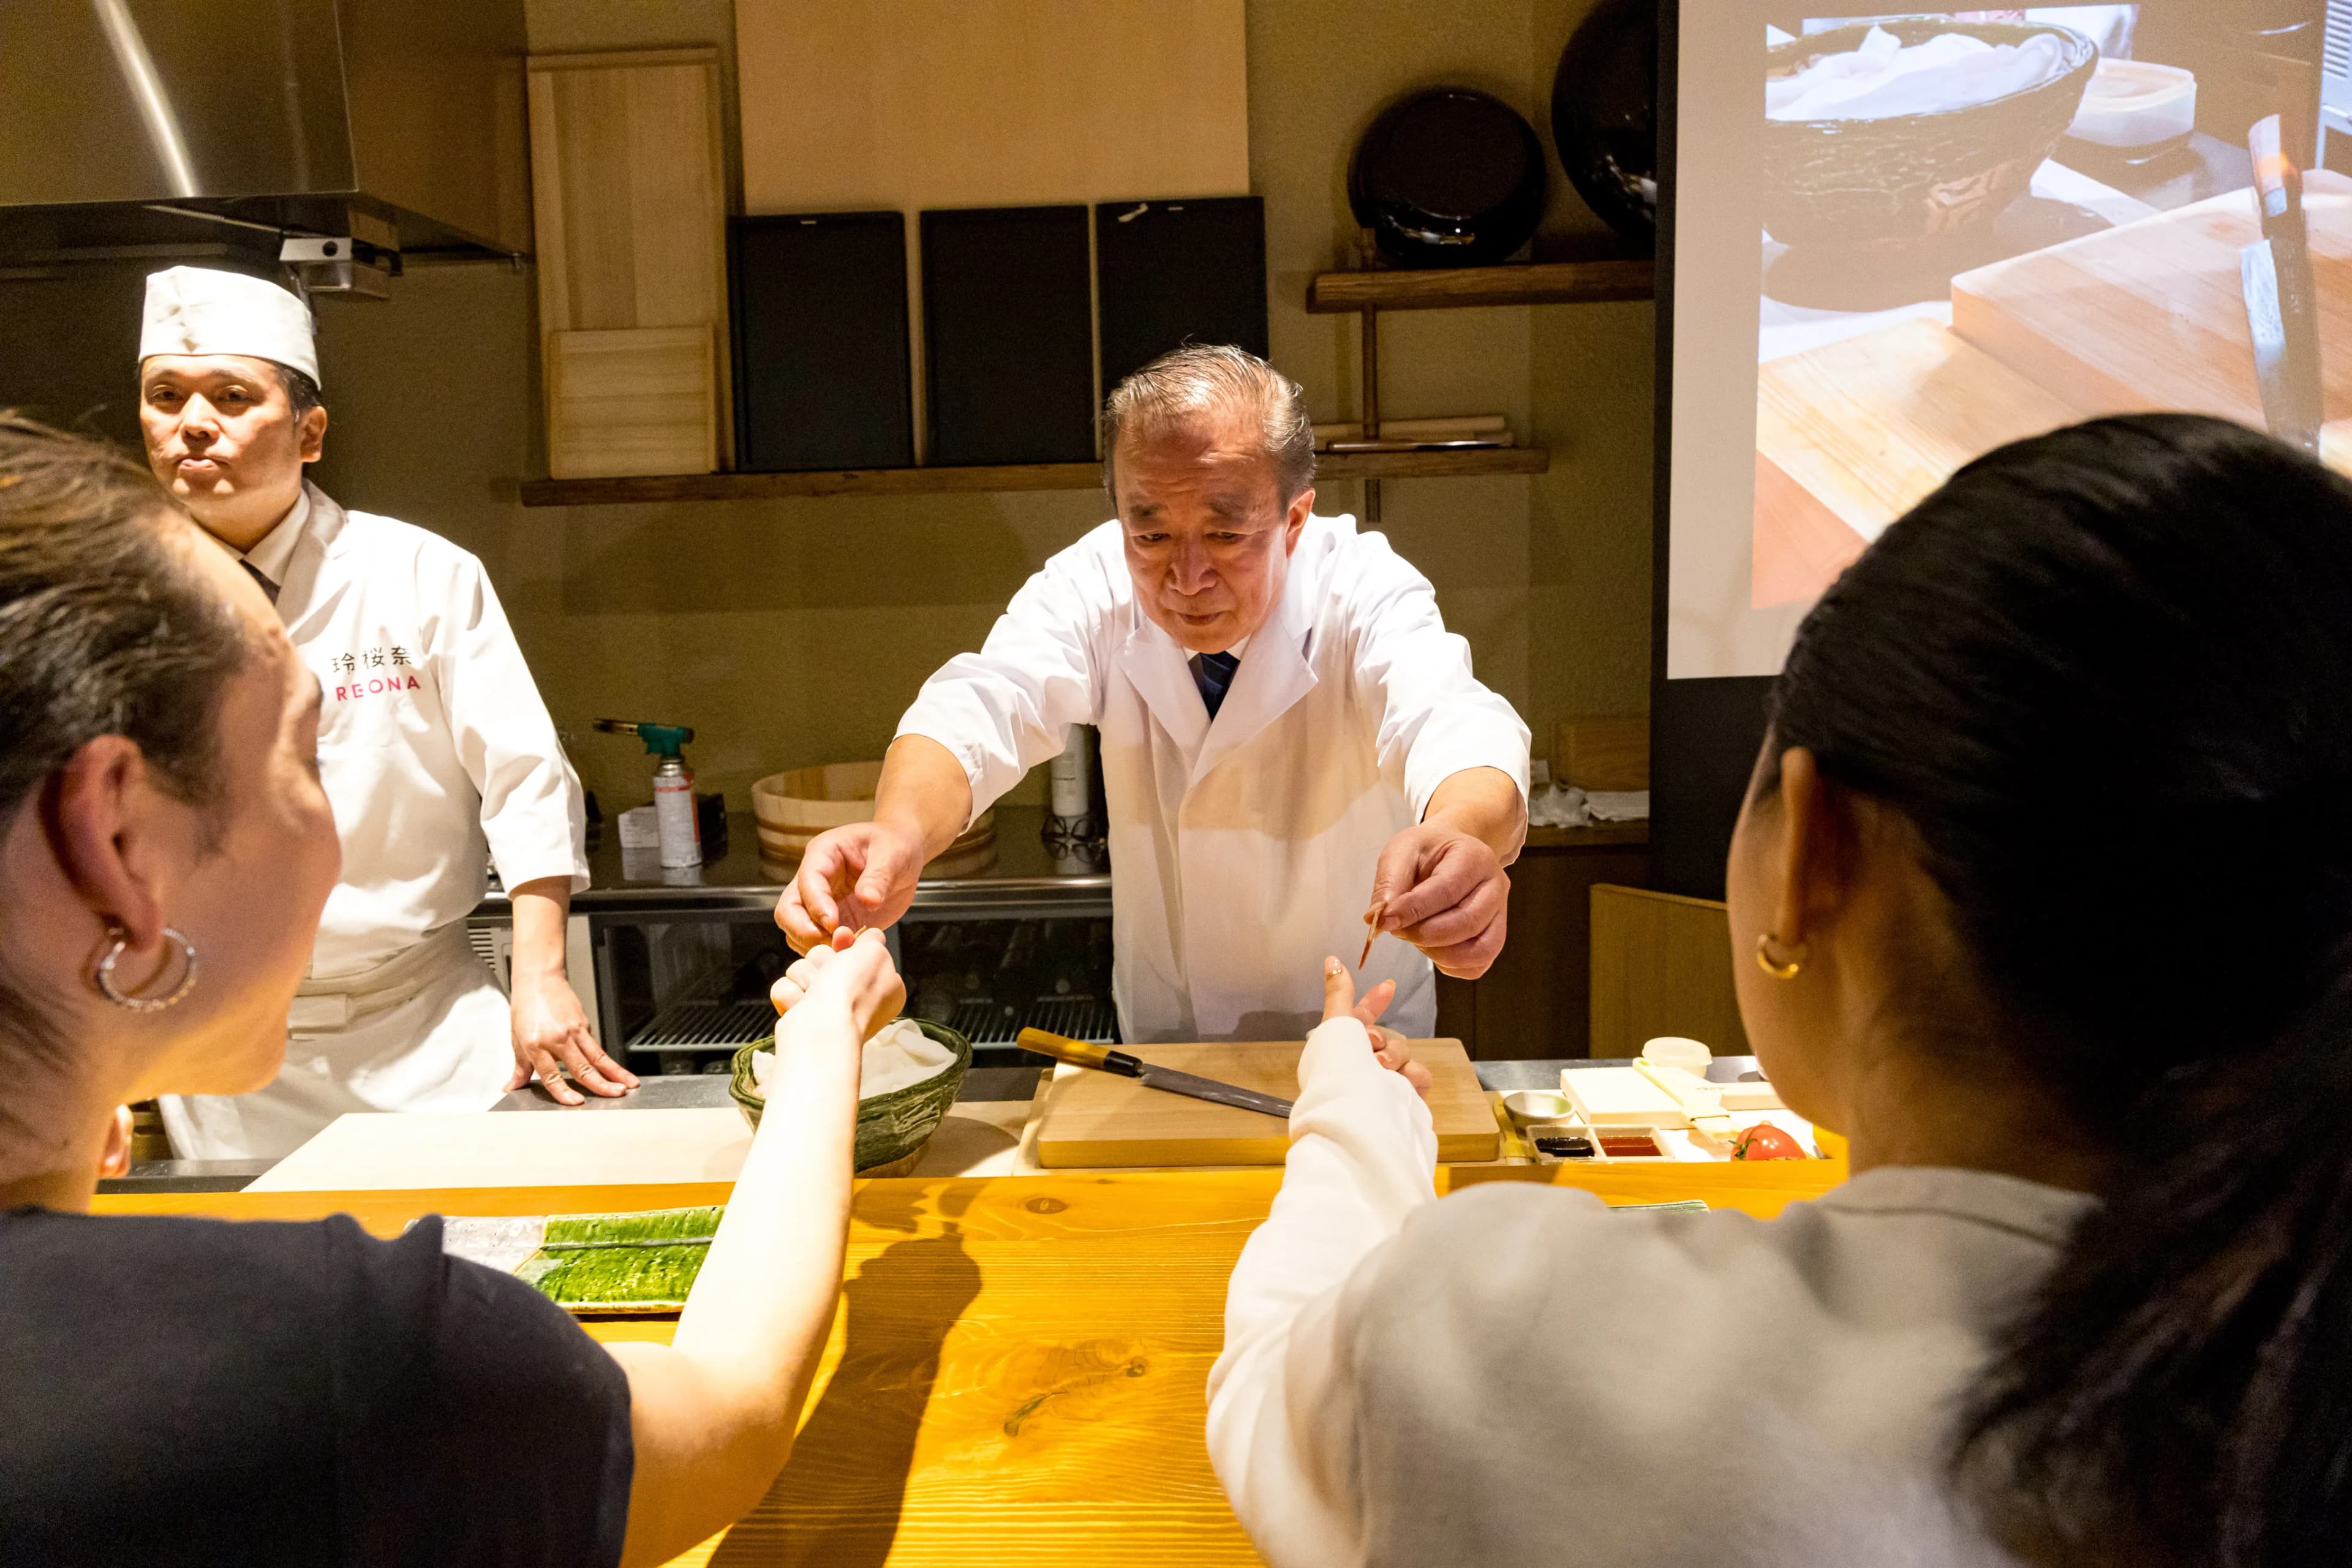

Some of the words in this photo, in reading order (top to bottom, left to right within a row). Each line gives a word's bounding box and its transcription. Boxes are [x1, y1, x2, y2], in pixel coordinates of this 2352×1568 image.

[331, 646, 412, 674] 玲桜奈
[336, 676, 421, 701] REONA
